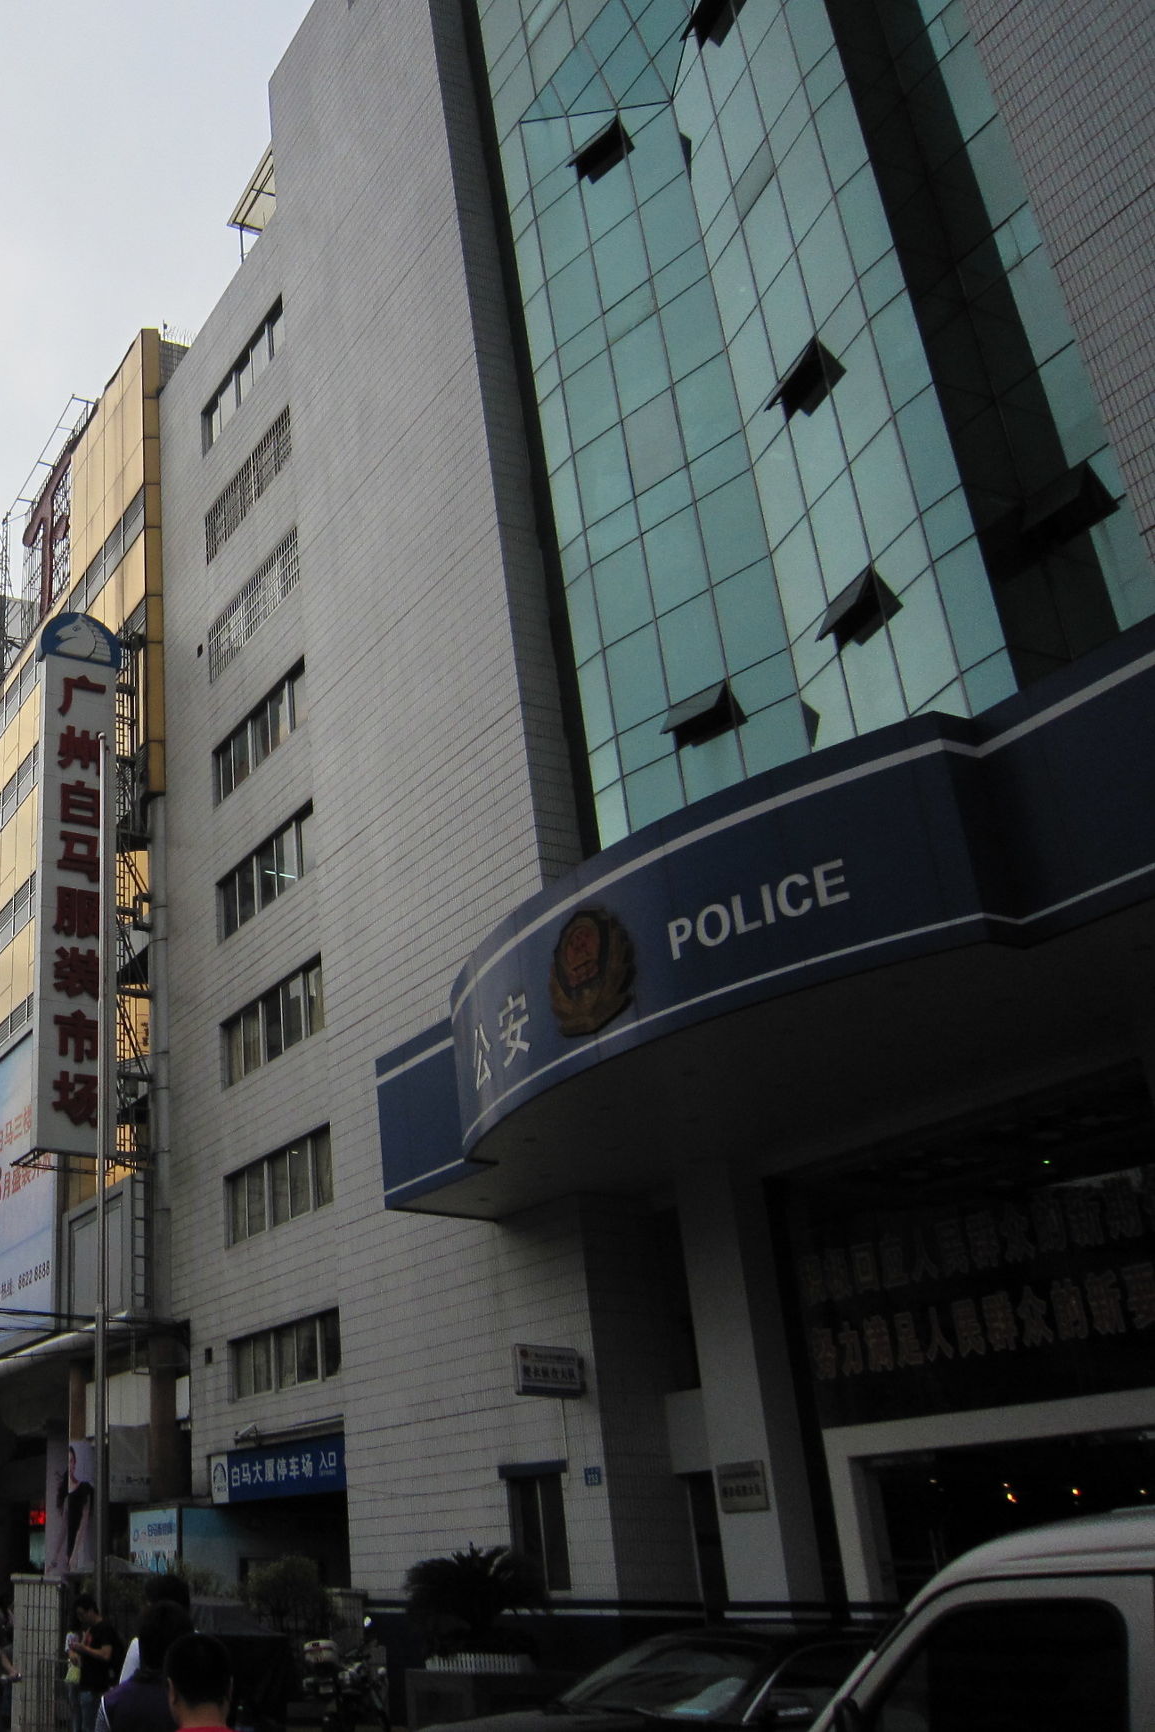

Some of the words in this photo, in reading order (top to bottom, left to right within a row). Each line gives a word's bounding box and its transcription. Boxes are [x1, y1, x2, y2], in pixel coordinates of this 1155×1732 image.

[52, 675, 106, 1129] 广州白马服装市场
[667, 857, 852, 962] POLICE
[471, 992, 533, 1093] 公安
[231, 1453, 314, 1487] 白马大厦停车场
[319, 1451, 337, 1470] 入口
